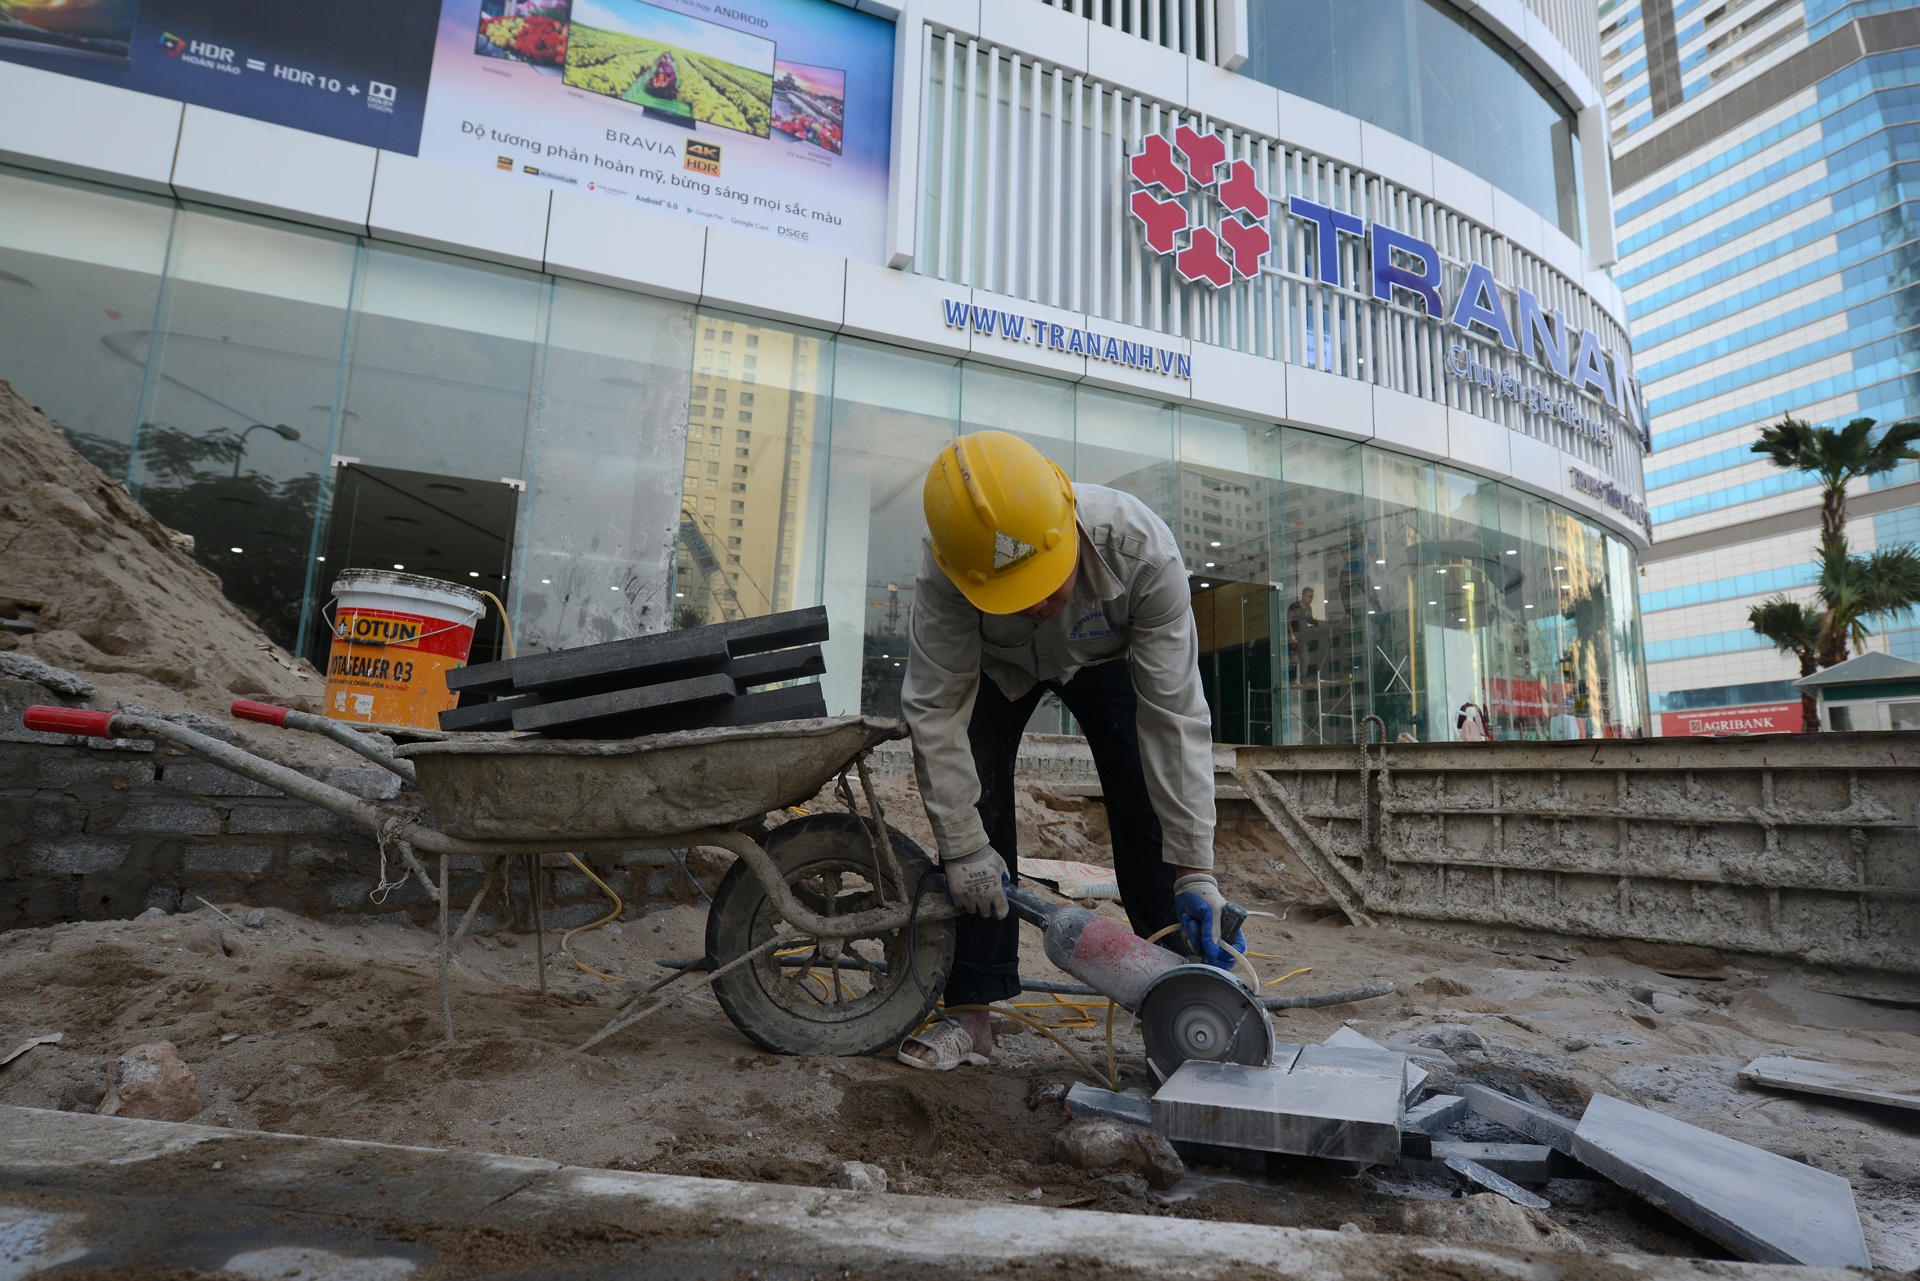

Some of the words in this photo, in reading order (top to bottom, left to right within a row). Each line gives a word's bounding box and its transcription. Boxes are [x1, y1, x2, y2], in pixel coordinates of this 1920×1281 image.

[713, 5, 769, 28] ANDROID
[189, 40, 235, 63] HDR
[606, 129, 676, 157] BRAVIA
[687, 143, 719, 159] 4K
[461, 120, 485, 140] Độ
[491, 129, 542, 154] tương
[547, 145, 589, 164] phản
[594, 154, 634, 175] hoàn
[639, 168, 666, 185] mỹ,
[671, 173, 710, 195] bừng
[715, 186, 749, 205] sáng
[753, 196, 781, 212] mọi
[785, 202, 807, 217] sắc
[811, 211, 842, 226] màu
[686, 158, 718, 174] HDR
[667, 201, 679, 210] 6.0
[695, 209, 714, 218] Google
[730, 216, 754, 227] Google
[755, 222, 769, 231] Cast
[777, 226, 809, 241] DSEE
[1289, 194, 1647, 444] TRANAN
[943, 298, 1192, 378] WWW.TRANANH.VN
[1446, 344, 1525, 400] Chuyên
[1529, 384, 1554, 414] gia
[1557, 396, 1588, 434] điện
[393, 661, 414, 683] 03
[1703, 717, 1775, 732] AGRIBANK
